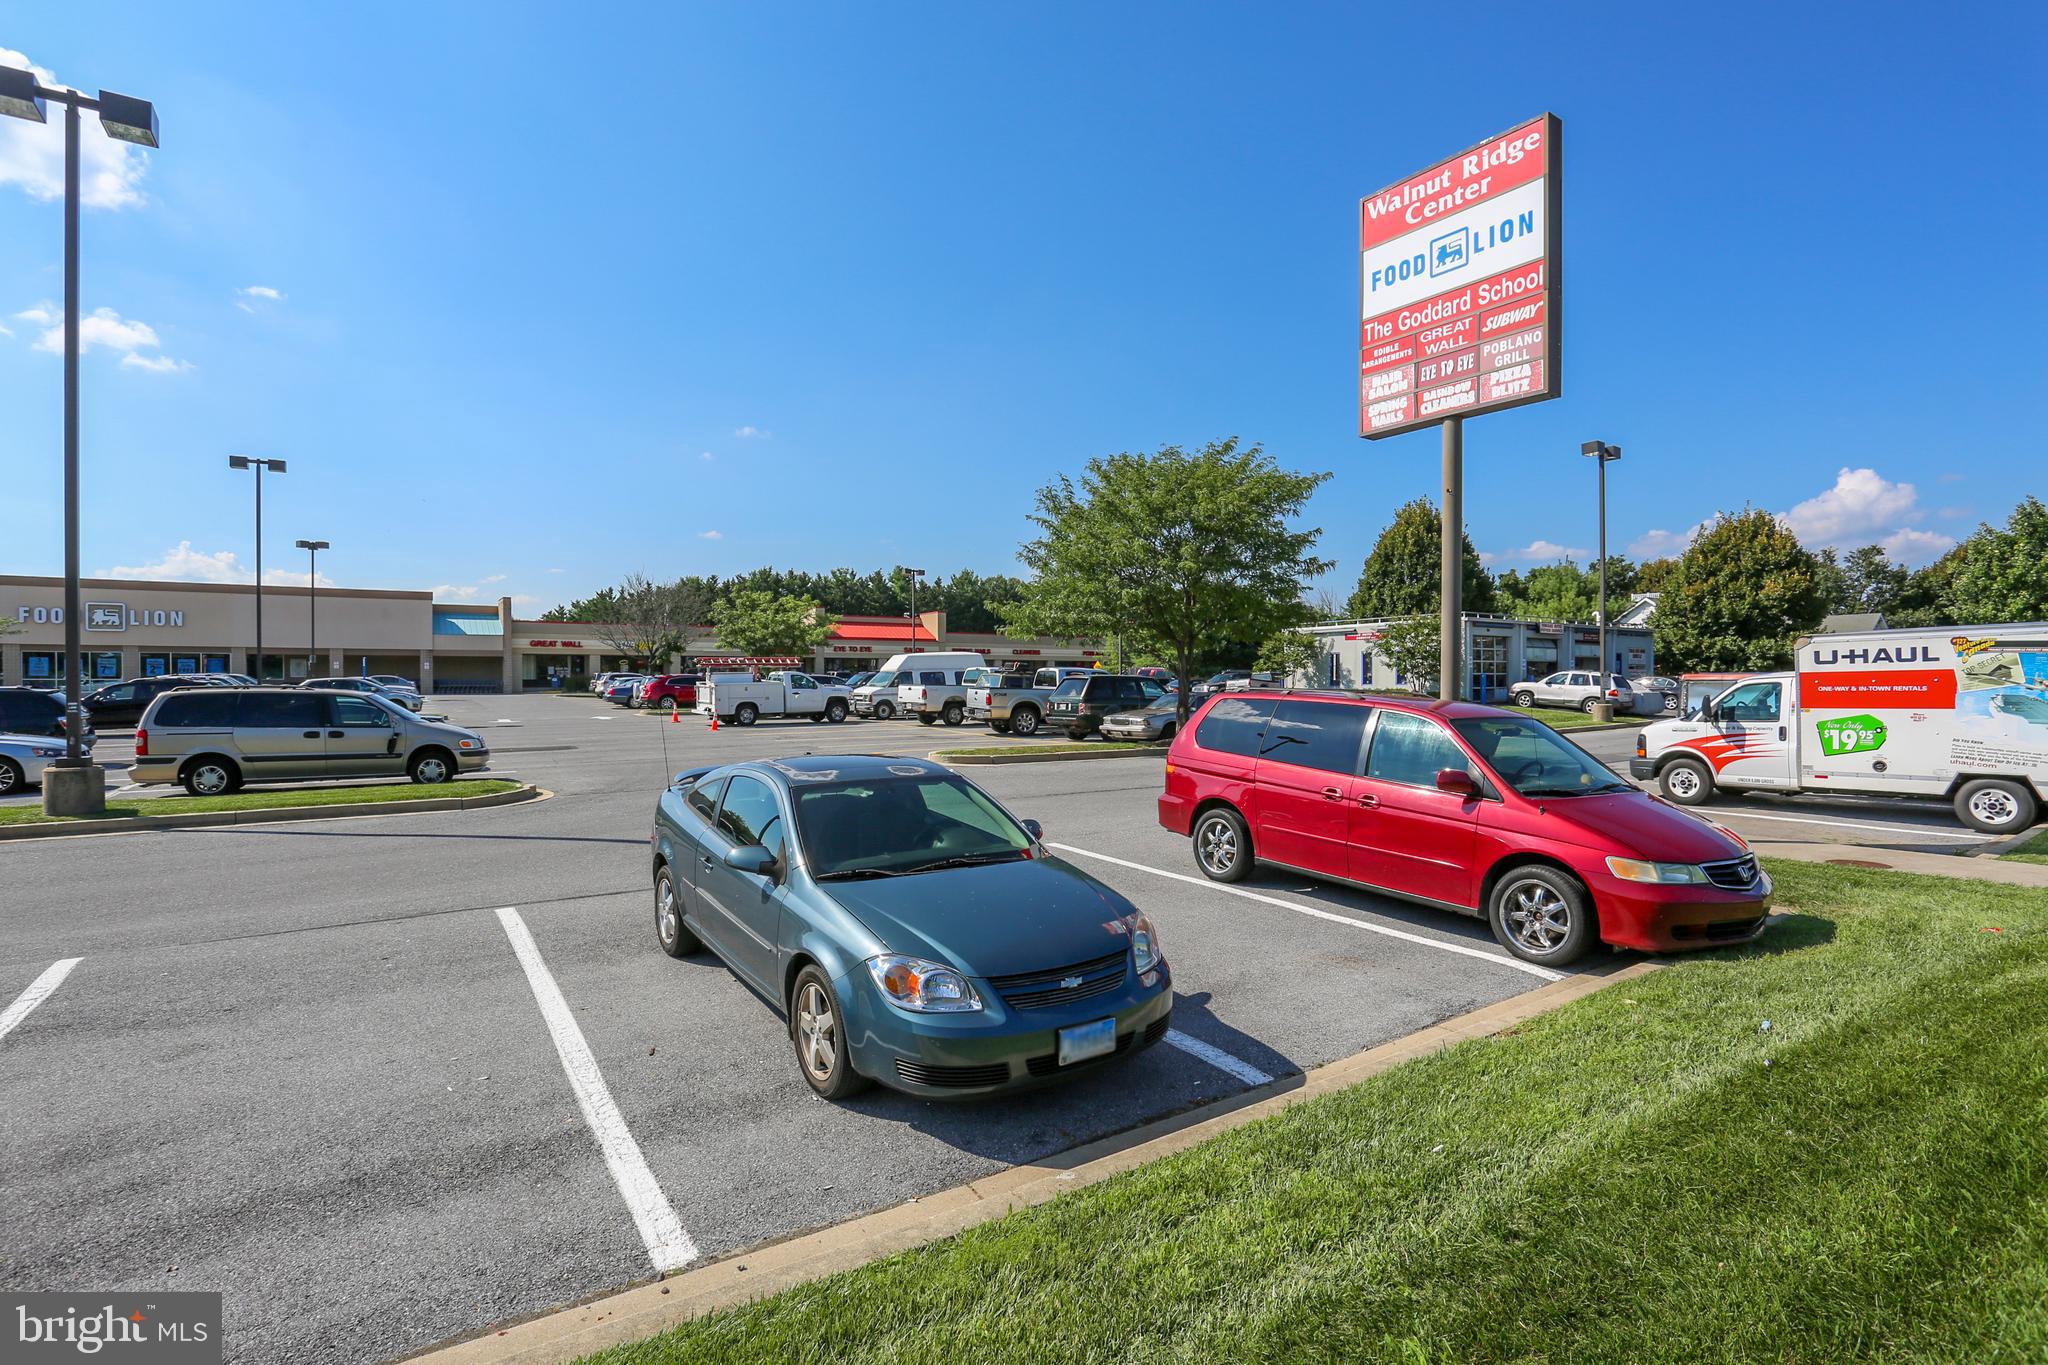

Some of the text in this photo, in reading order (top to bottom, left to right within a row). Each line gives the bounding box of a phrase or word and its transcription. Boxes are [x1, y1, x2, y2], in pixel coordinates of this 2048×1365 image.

[1367, 131, 1541, 220] Walnut Ridge
[1405, 176, 1492, 225] Center
[1372, 210, 1534, 292] FOOD LION
[1364, 265, 1544, 343] The Goddard School
[1482, 301, 1544, 333] SUBWAY
[1419, 317, 1473, 343] GREAT
[1373, 342, 1400, 358] EDIBLE
[1424, 335, 1469, 355] WALL
[1483, 330, 1542, 357] POBLANO
[1362, 348, 1412, 370] ARRANGEMENTS
[1421, 352, 1475, 382] EYE TO EYE
[1495, 349, 1530, 368] GRILL
[1367, 379, 1409, 400] SALON
[1491, 378, 1531, 399] BLITZ
[1371, 412, 1404, 428] NAILS
[18, 606, 184, 627] FOO LION
[529, 640, 583, 648] GREAT WALL
[1813, 646, 1940, 665] U-HAUL
[1977, 651, 2006, 670] SECRET
[1824, 720, 1864, 731] Now Only
[1950, 759, 1998, 769] uhaul.com
